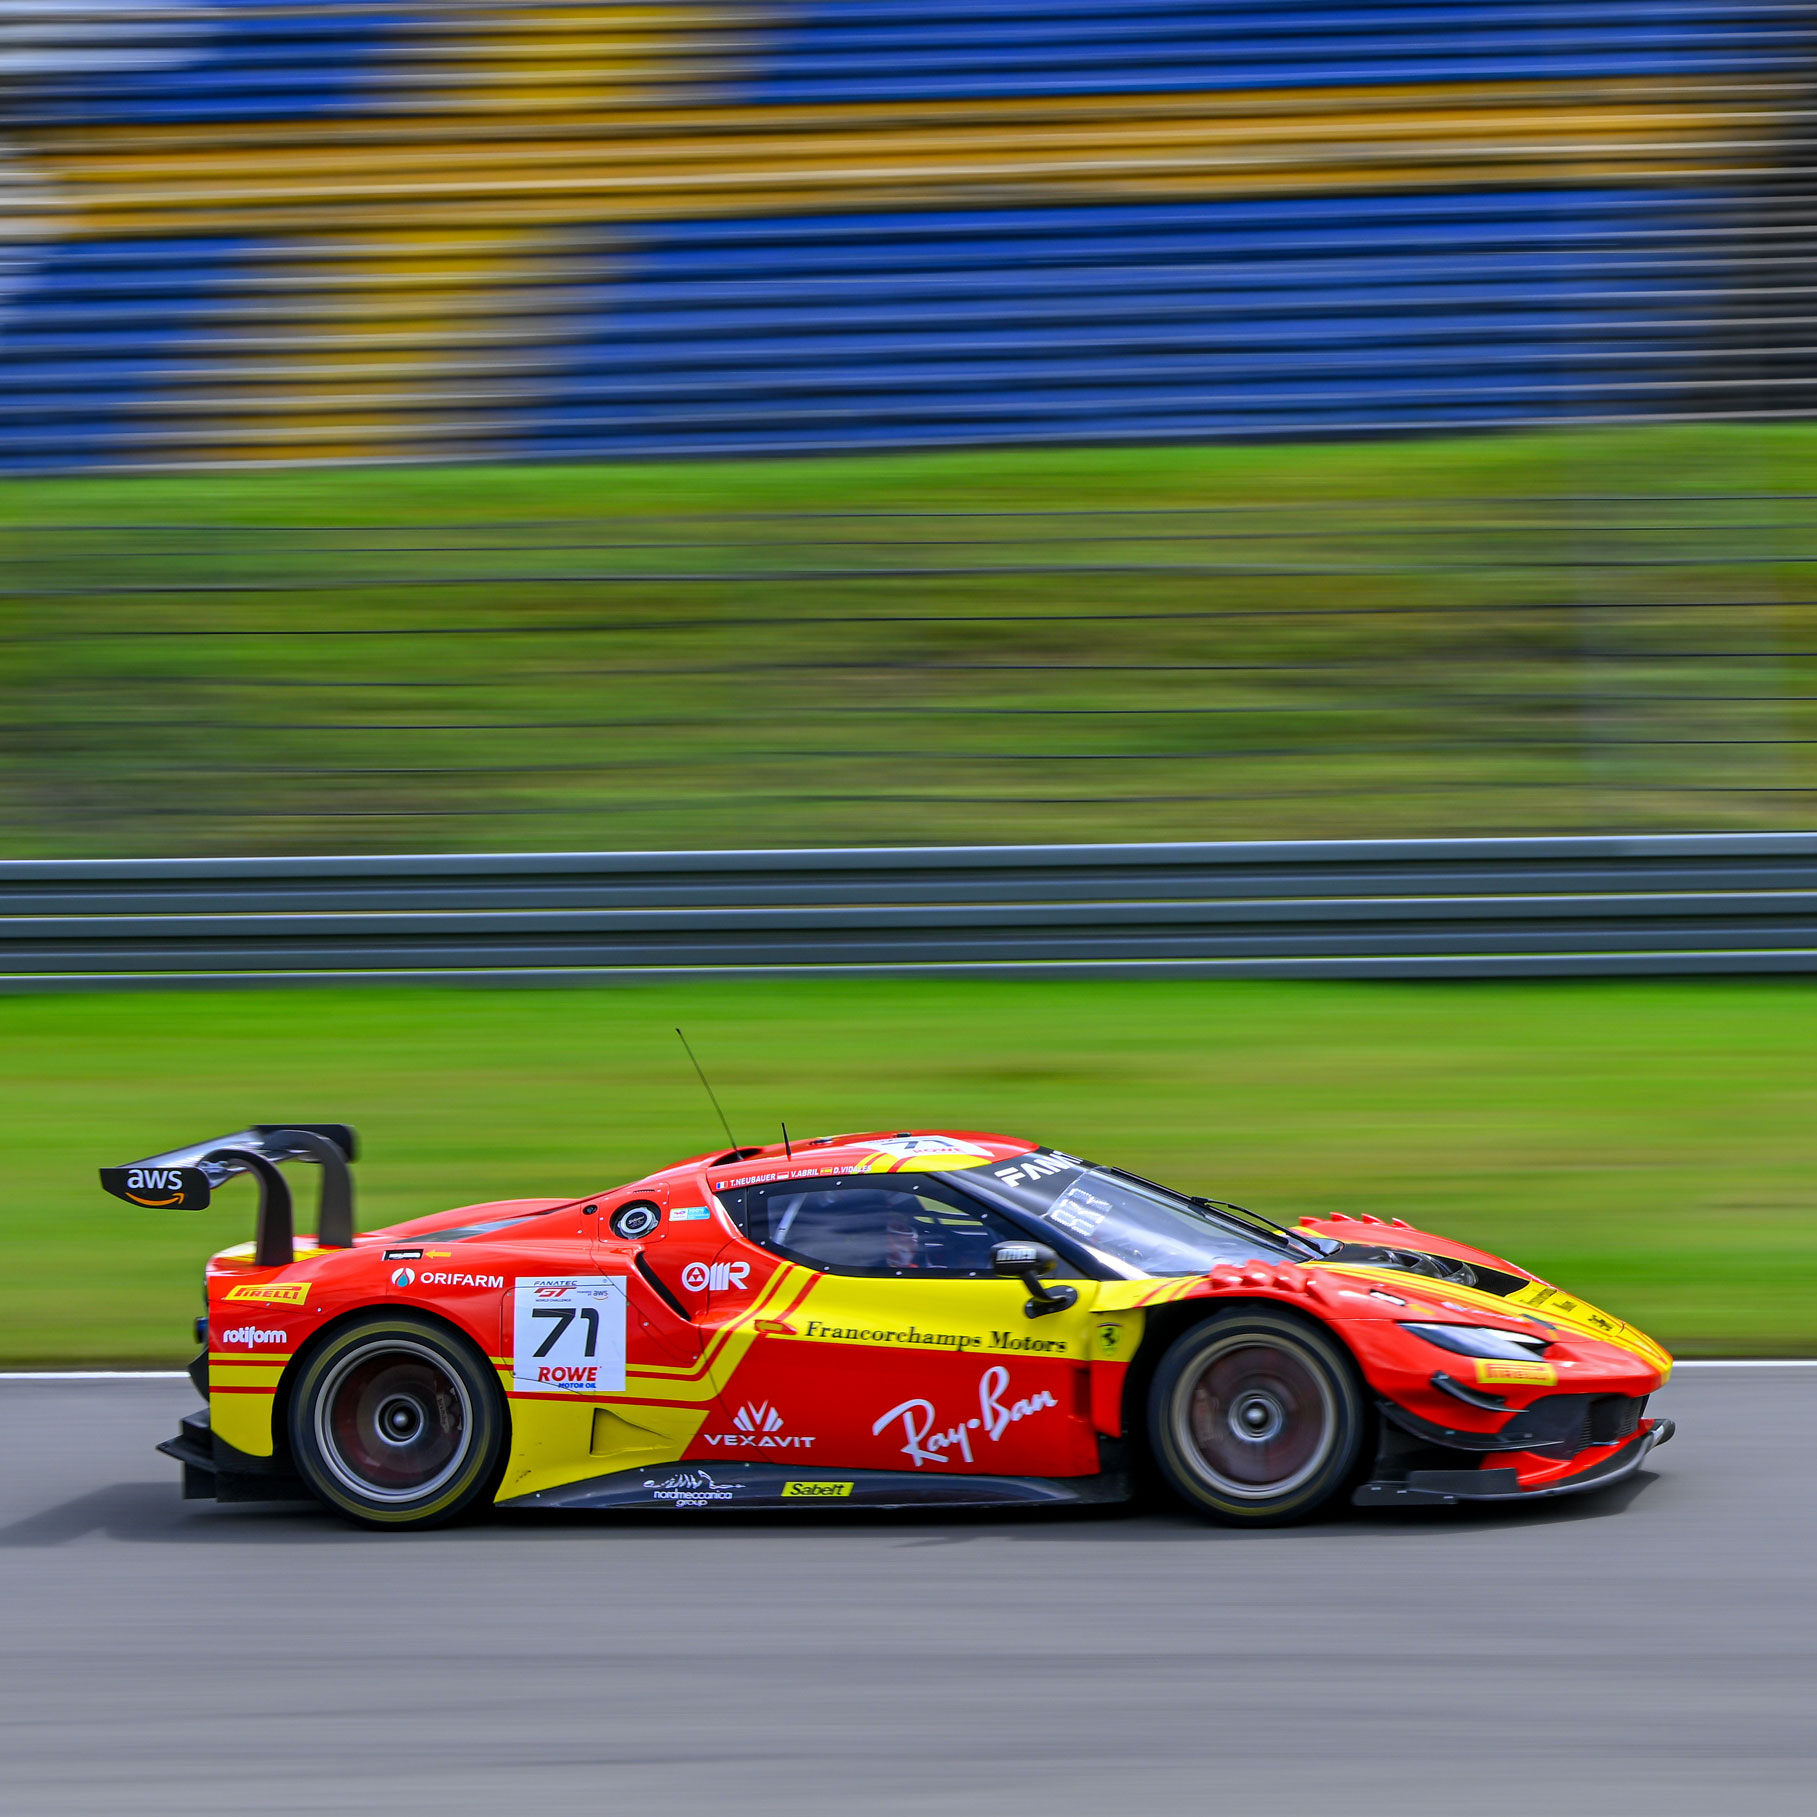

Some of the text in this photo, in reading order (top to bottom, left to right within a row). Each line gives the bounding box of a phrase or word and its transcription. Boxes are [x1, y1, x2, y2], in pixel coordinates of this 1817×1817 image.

[127, 1169, 183, 1190] aws
[730, 1165, 872, 1187] T.NEUBAUER V.ABRIL D.VIDALES
[420, 1272, 504, 1289] ORIFARM
[234, 1286, 302, 1300] PIRELLI
[533, 1287, 577, 1297] GT
[223, 1326, 288, 1349] rotiform
[531, 1307, 600, 1357] 71
[805, 1321, 1067, 1353] Francorchamps Motors
[537, 1366, 598, 1382] ROWE
[703, 1434, 817, 1448] VEXAVIT
[653, 1488, 733, 1500] nordmeccanica
[789, 1482, 845, 1496] Sabelt
[675, 1499, 709, 1508] group
